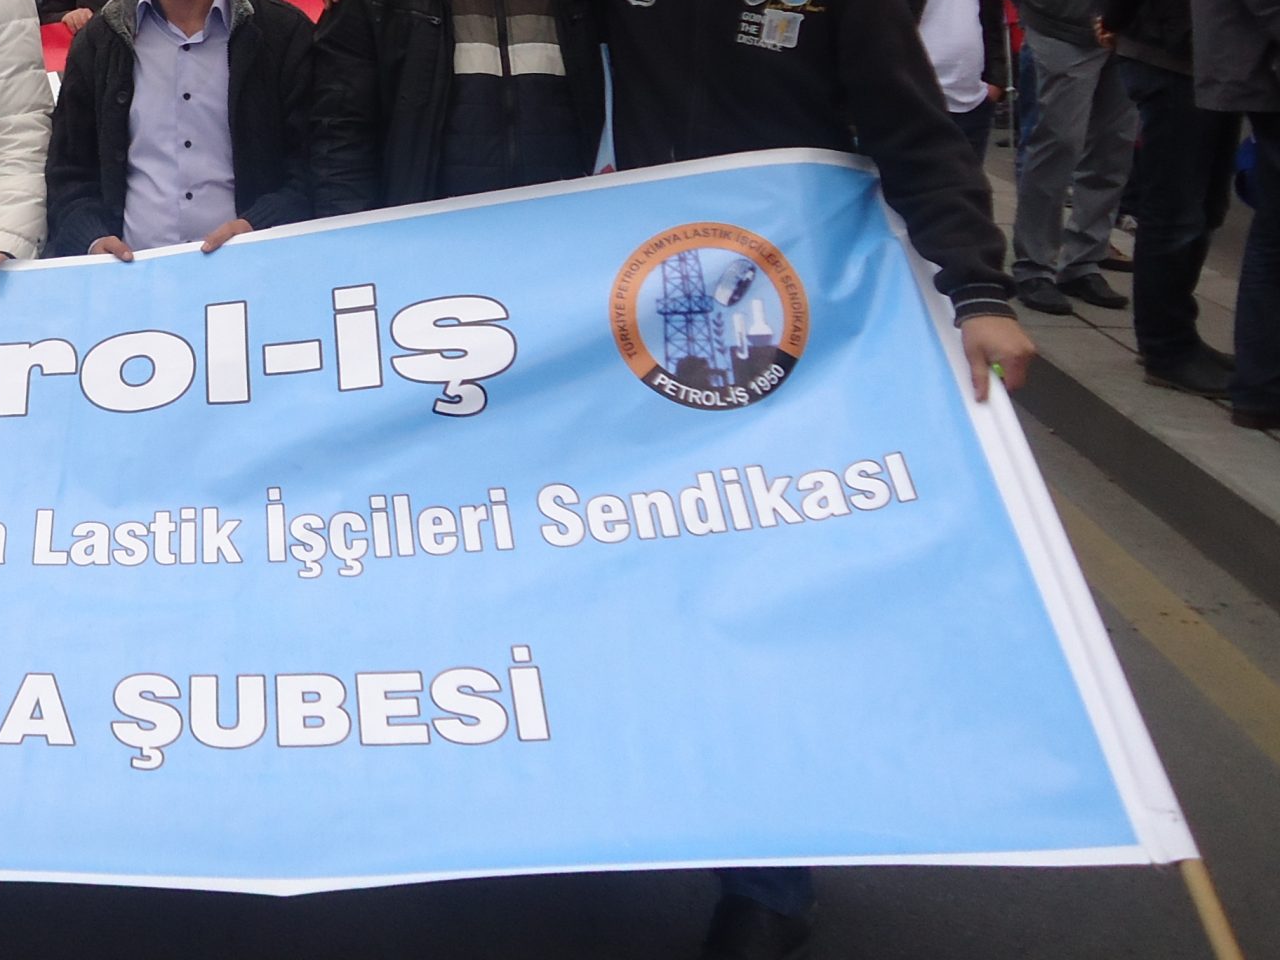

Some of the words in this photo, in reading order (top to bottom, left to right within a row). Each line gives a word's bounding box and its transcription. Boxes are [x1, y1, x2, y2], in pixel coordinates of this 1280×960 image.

[616, 259, 646, 301] PETROL
[653, 372, 750, 408] PETROL-İŞ
[750, 364, 786, 396] 1950
[31, 506, 244, 566] Lastik
[265, 485, 515, 580] İşçileri
[536, 450, 918, 547] Sendikası
[109, 643, 552, 771] ŞUBESİ
